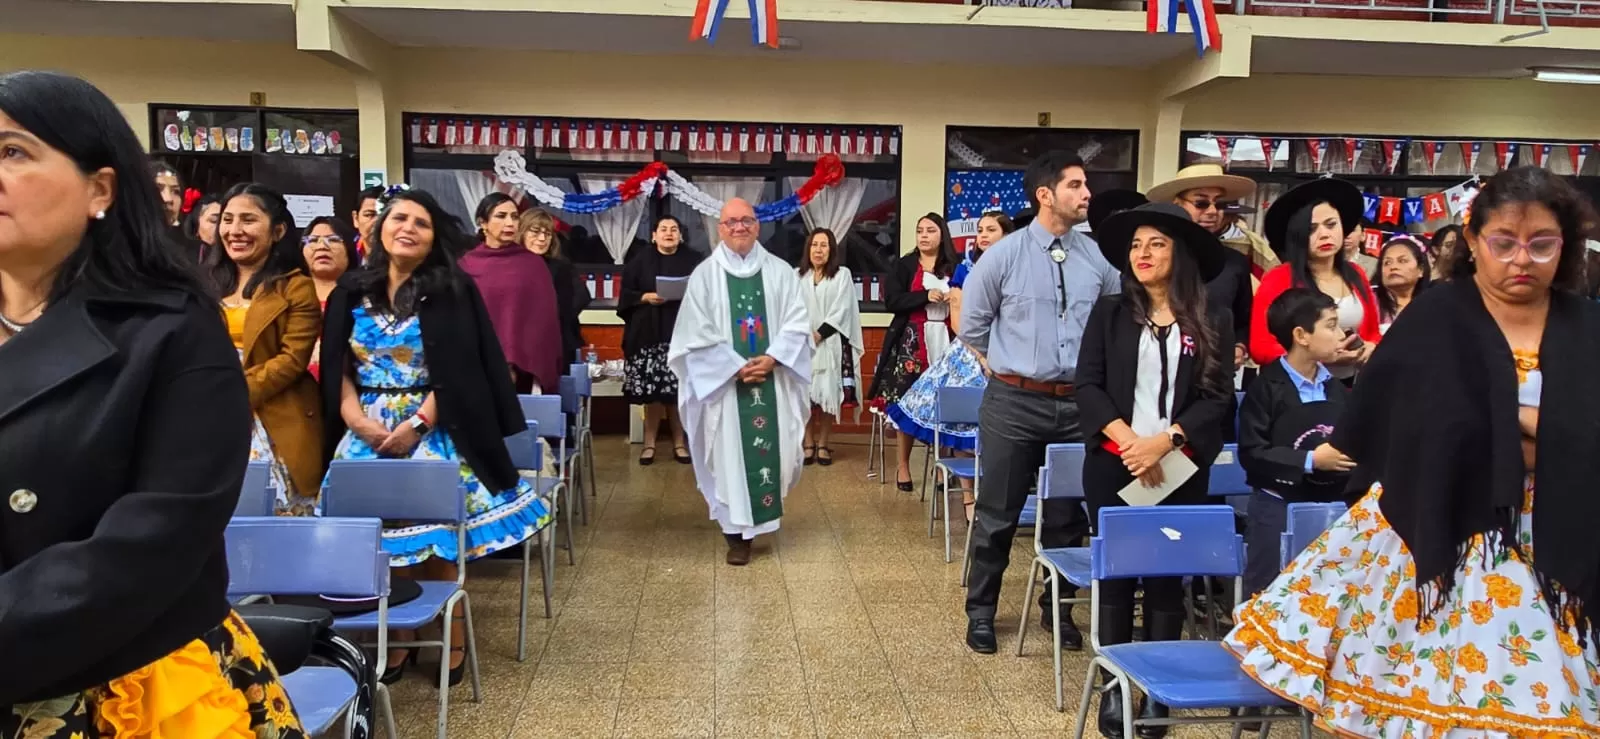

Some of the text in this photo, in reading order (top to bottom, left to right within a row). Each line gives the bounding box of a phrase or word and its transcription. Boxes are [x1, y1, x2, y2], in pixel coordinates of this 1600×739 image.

[1039, 112, 1048, 126] 2
[1363, 196, 1443, 217] VIVA
[960, 222, 975, 233] VIVA
